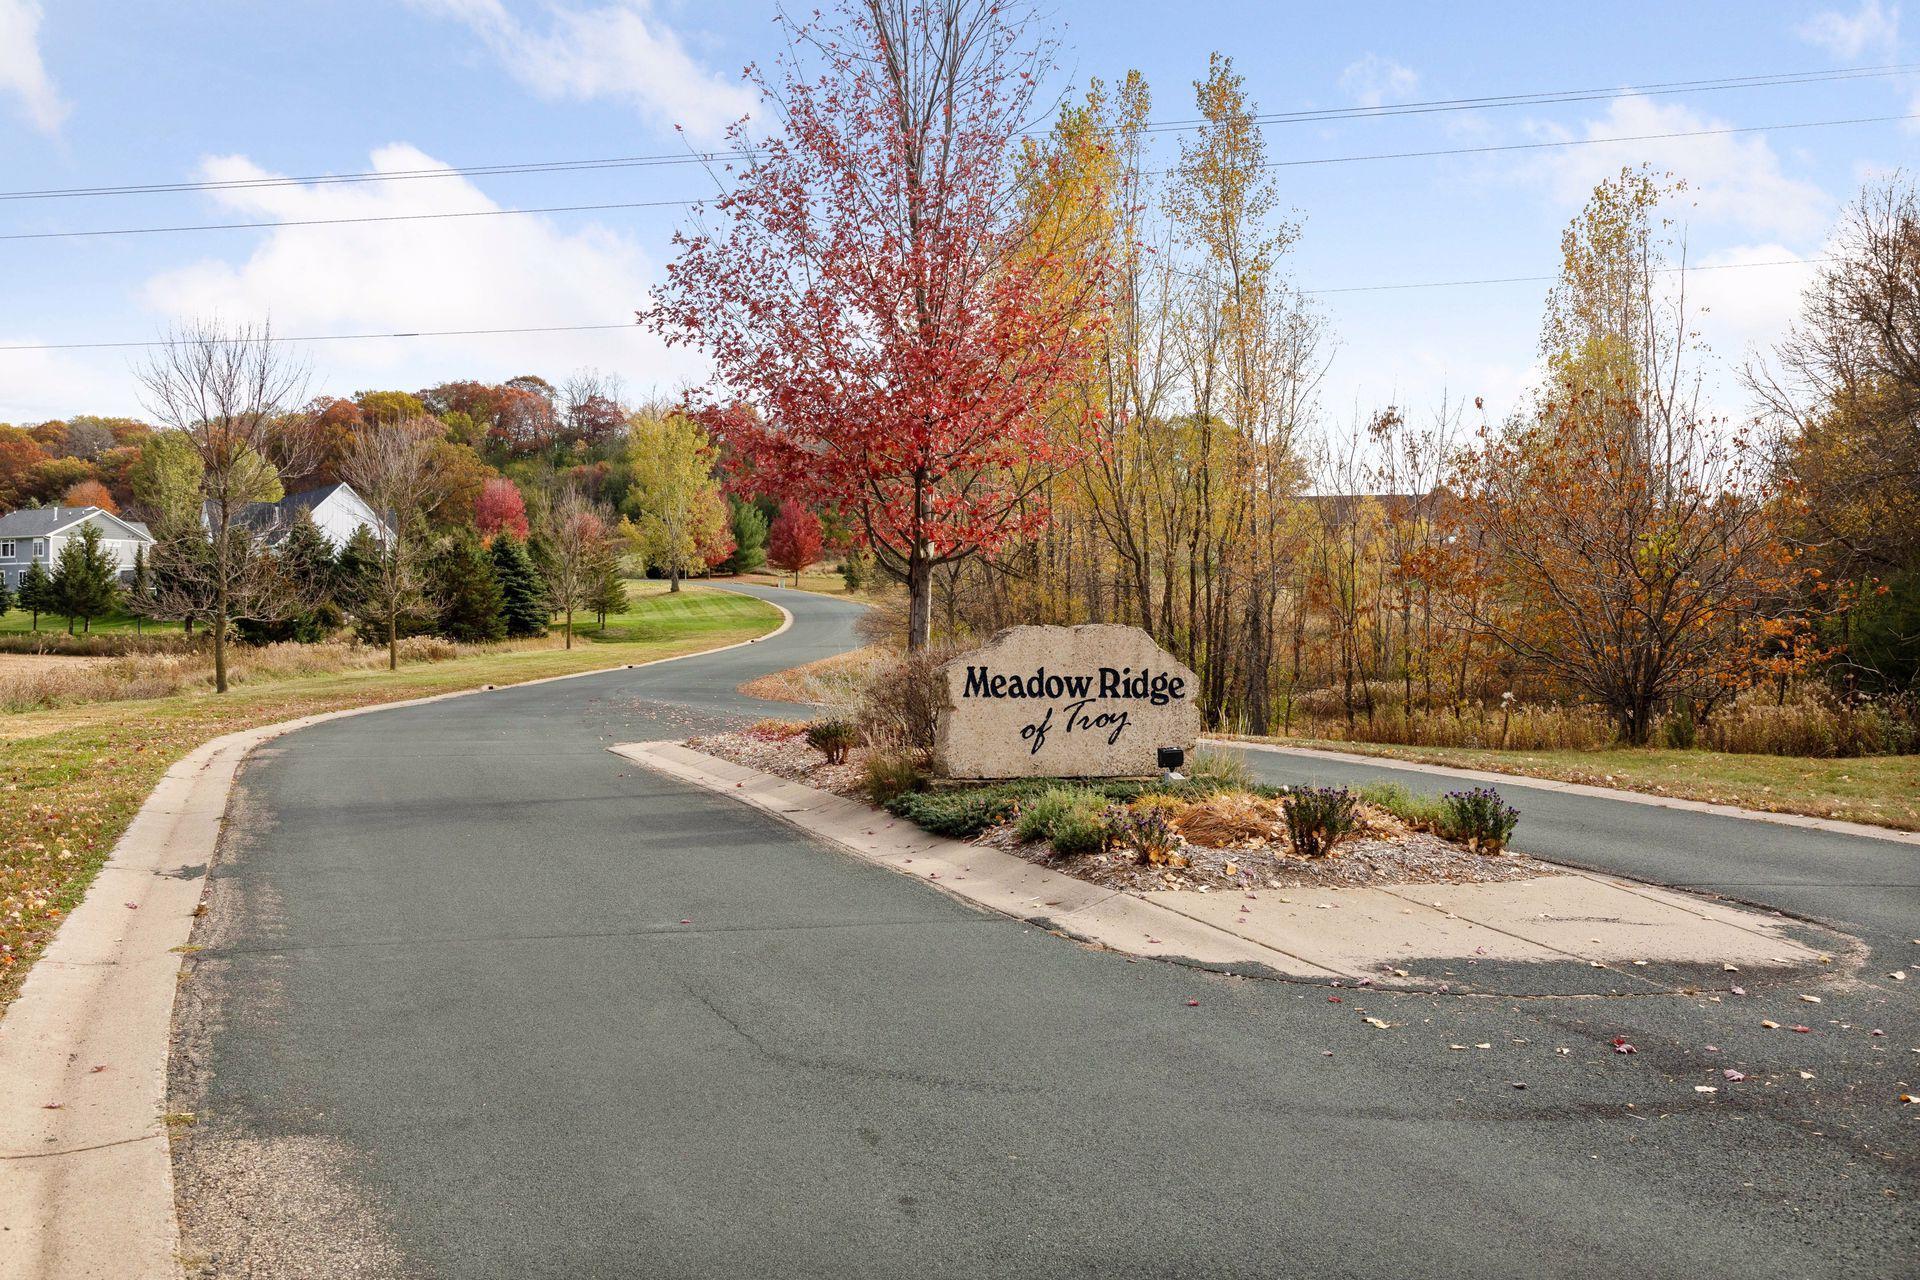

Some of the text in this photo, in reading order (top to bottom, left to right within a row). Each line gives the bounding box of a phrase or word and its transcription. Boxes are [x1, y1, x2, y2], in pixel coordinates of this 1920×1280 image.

[963, 666, 1185, 705] Meadow Ridge
[1020, 698, 1131, 755] of Troy
